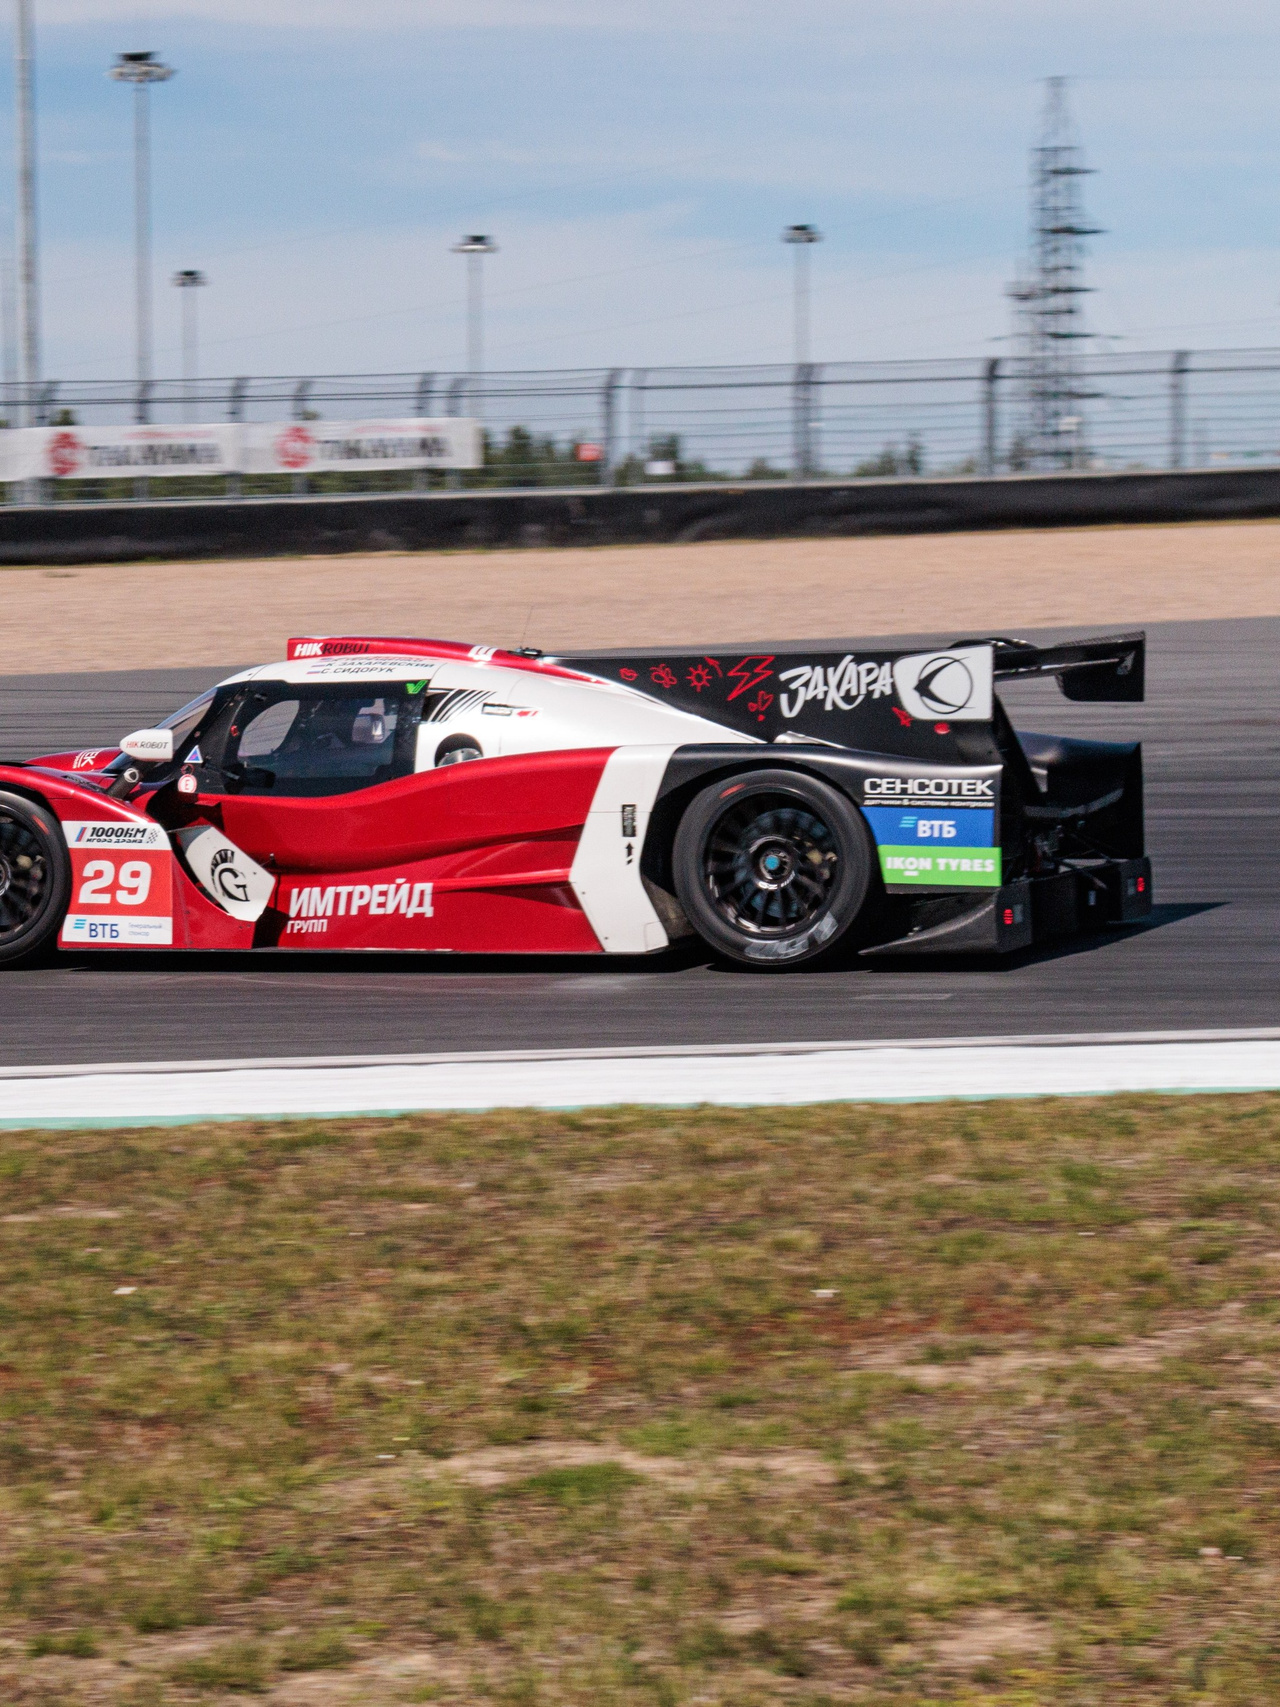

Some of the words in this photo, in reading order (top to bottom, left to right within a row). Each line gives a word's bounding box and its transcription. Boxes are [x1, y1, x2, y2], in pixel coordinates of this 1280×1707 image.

[778, 654, 894, 718] ЗАХАРА
[863, 777, 995, 795] СЕНСОТЕК
[916, 819, 957, 838] ВТБ
[885, 857, 933, 871] IKON
[936, 858, 995, 872] TYRES
[78, 859, 152, 906] 29
[288, 877, 435, 919] ИМТРЕЙД
[89, 922, 120, 939] ВТБ
[286, 918, 328, 934] ГРУПП
